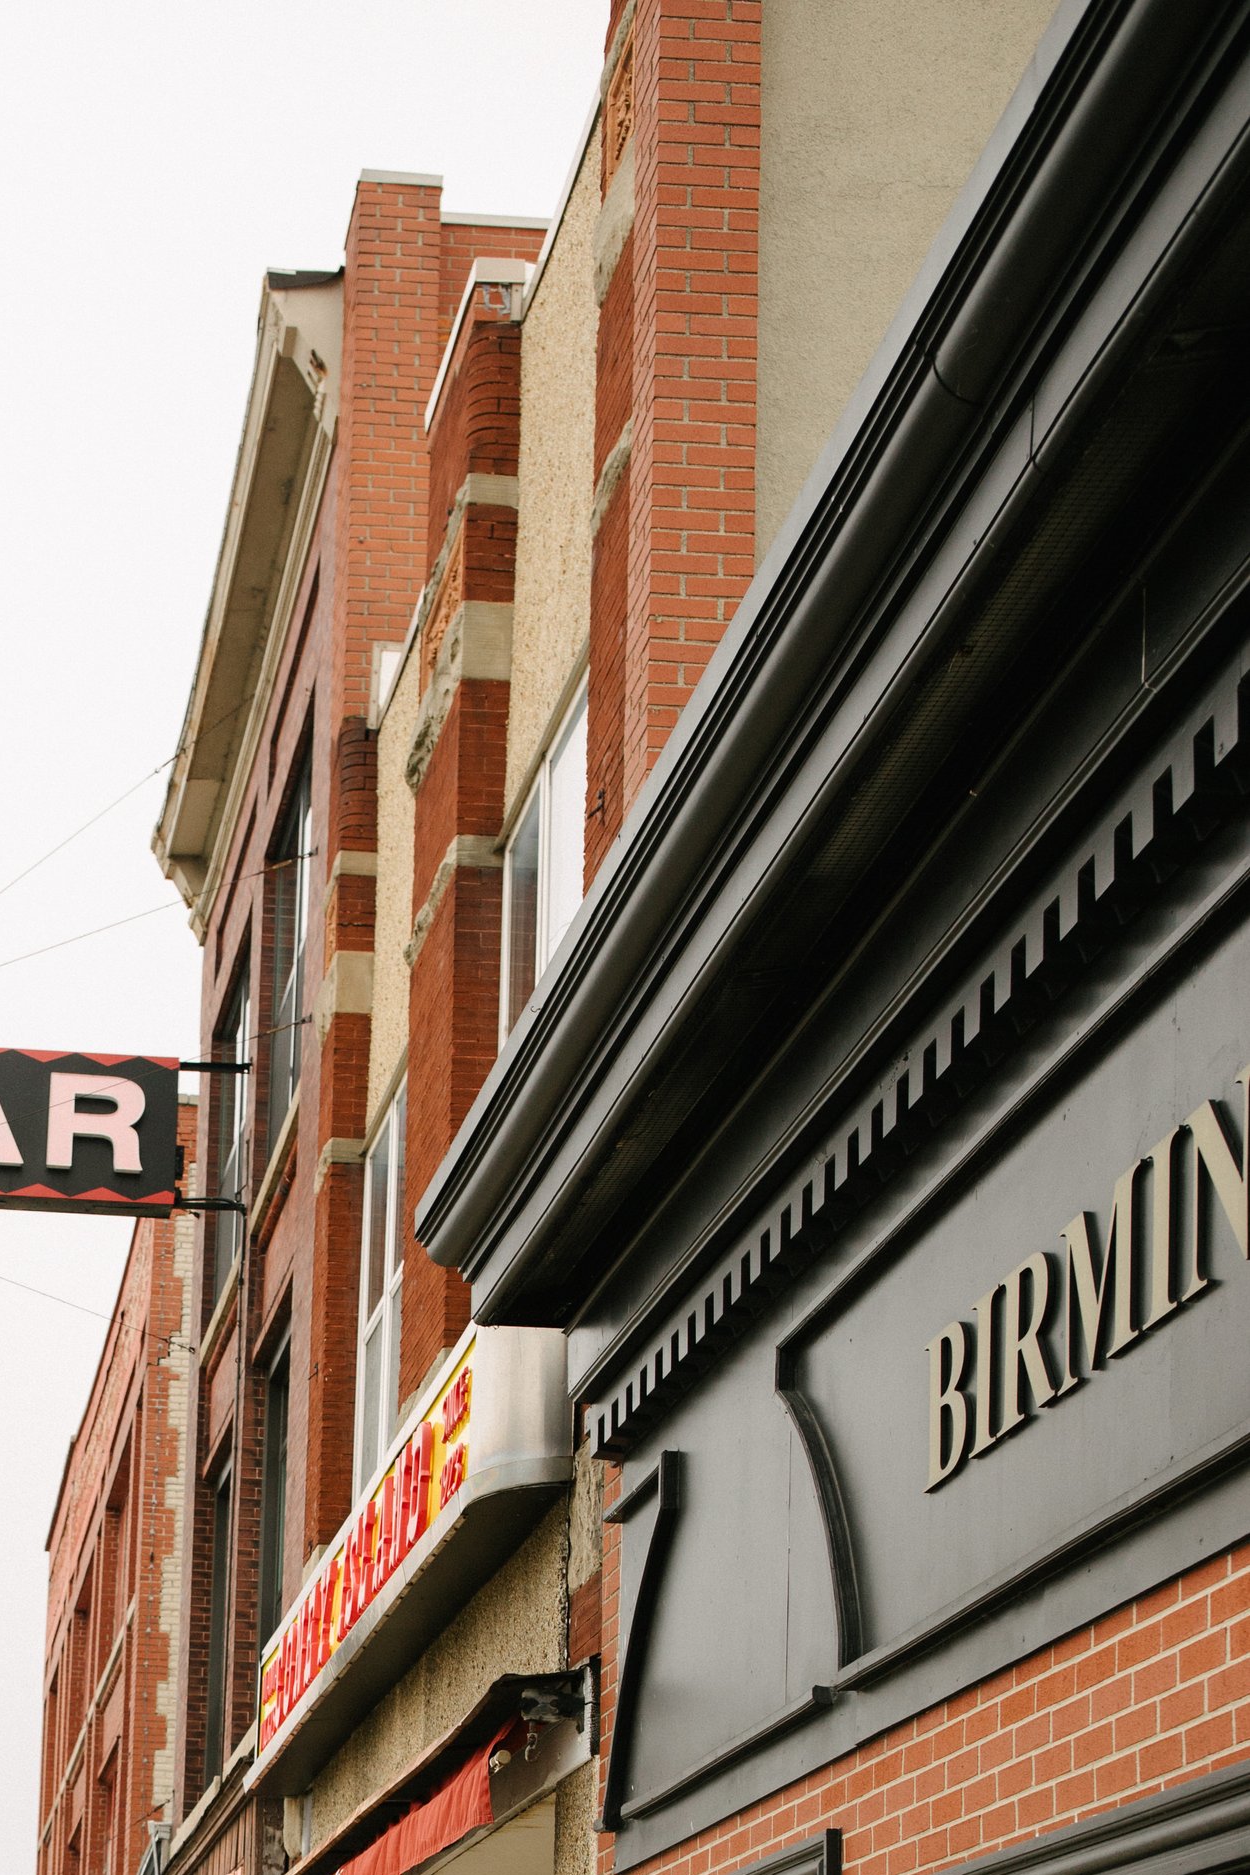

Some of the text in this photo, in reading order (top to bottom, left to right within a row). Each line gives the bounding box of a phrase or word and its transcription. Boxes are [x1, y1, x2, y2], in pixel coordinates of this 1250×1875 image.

[924, 1063, 1250, 1494] BIRMIN
[276, 1421, 434, 1726] CONEY ISLAND
